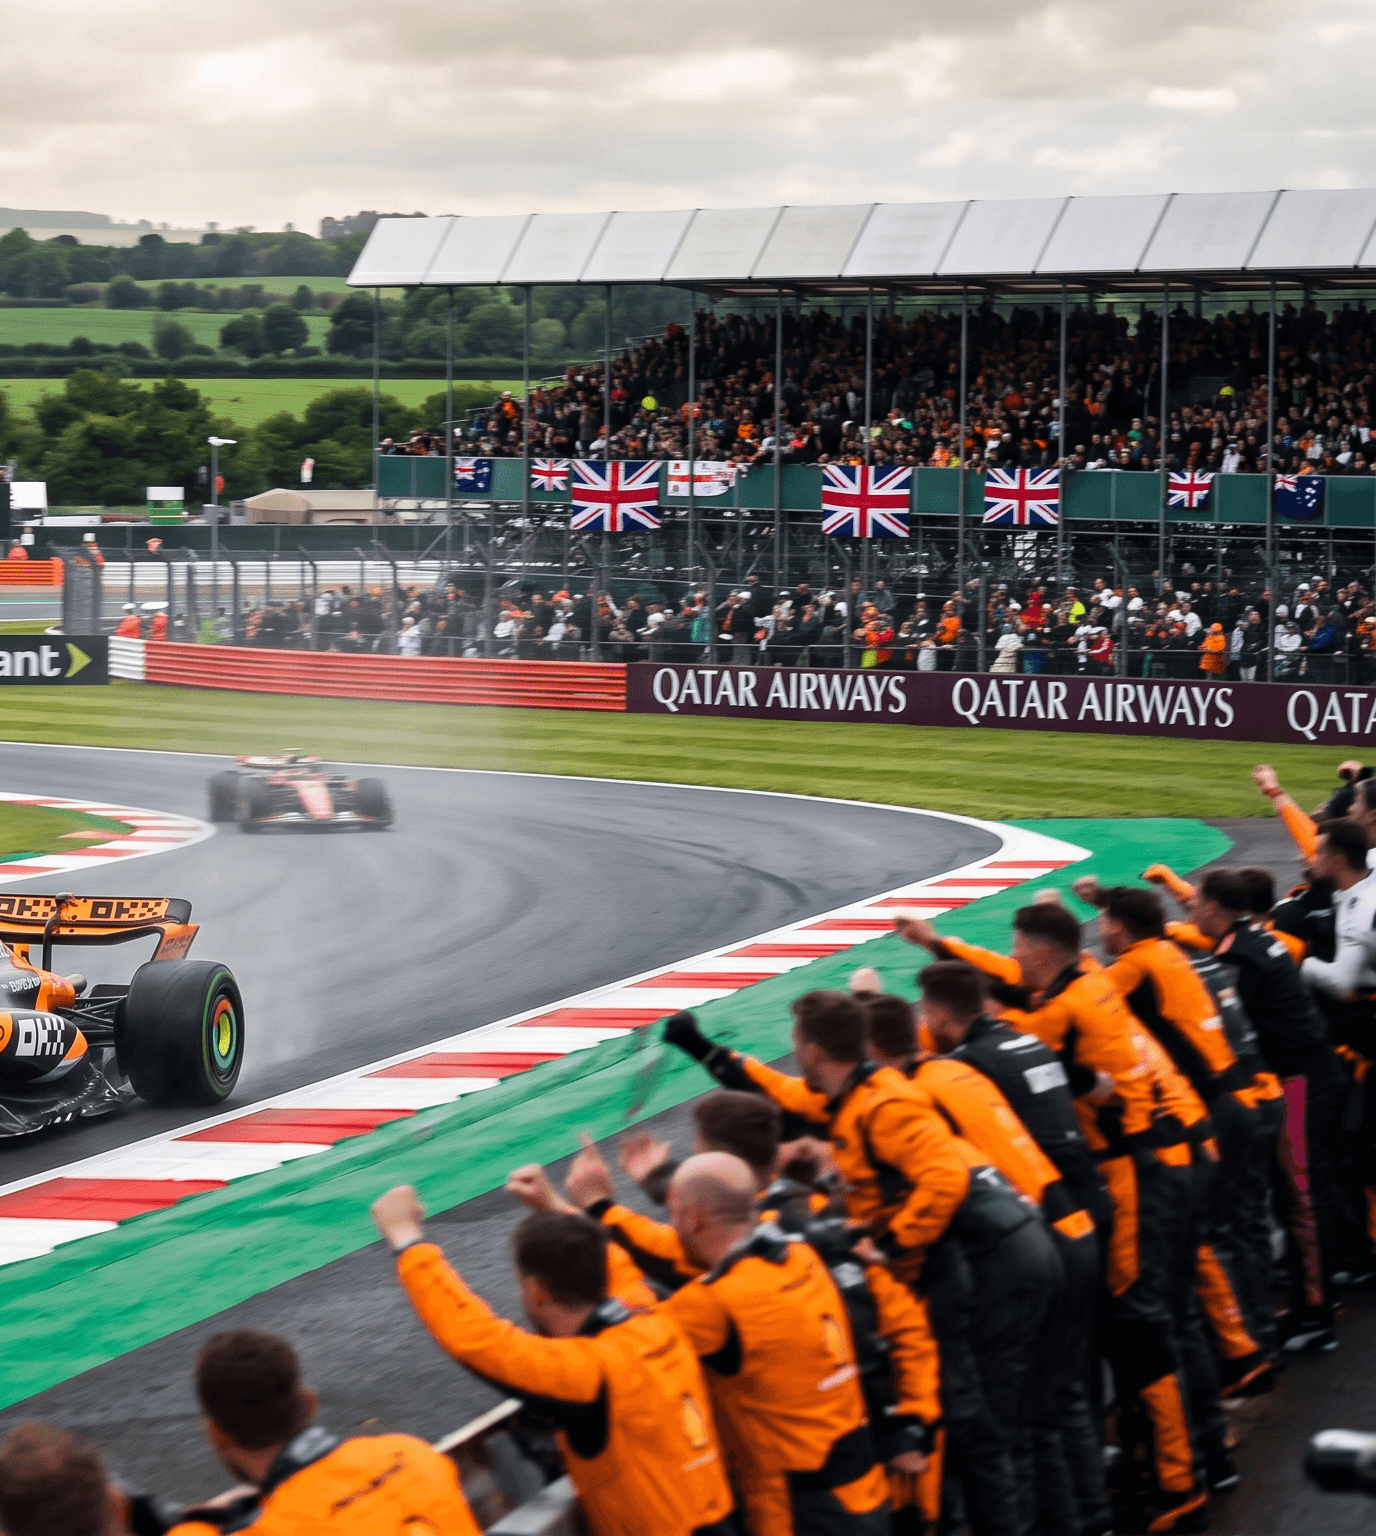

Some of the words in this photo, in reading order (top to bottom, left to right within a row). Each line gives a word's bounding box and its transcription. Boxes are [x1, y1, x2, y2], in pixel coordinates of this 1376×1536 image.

[652, 668, 758, 712] QATAR
[765, 671, 907, 714] AIRWAYS
[952, 678, 1069, 725] QATAR
[1078, 682, 1235, 728] AIRWAYS
